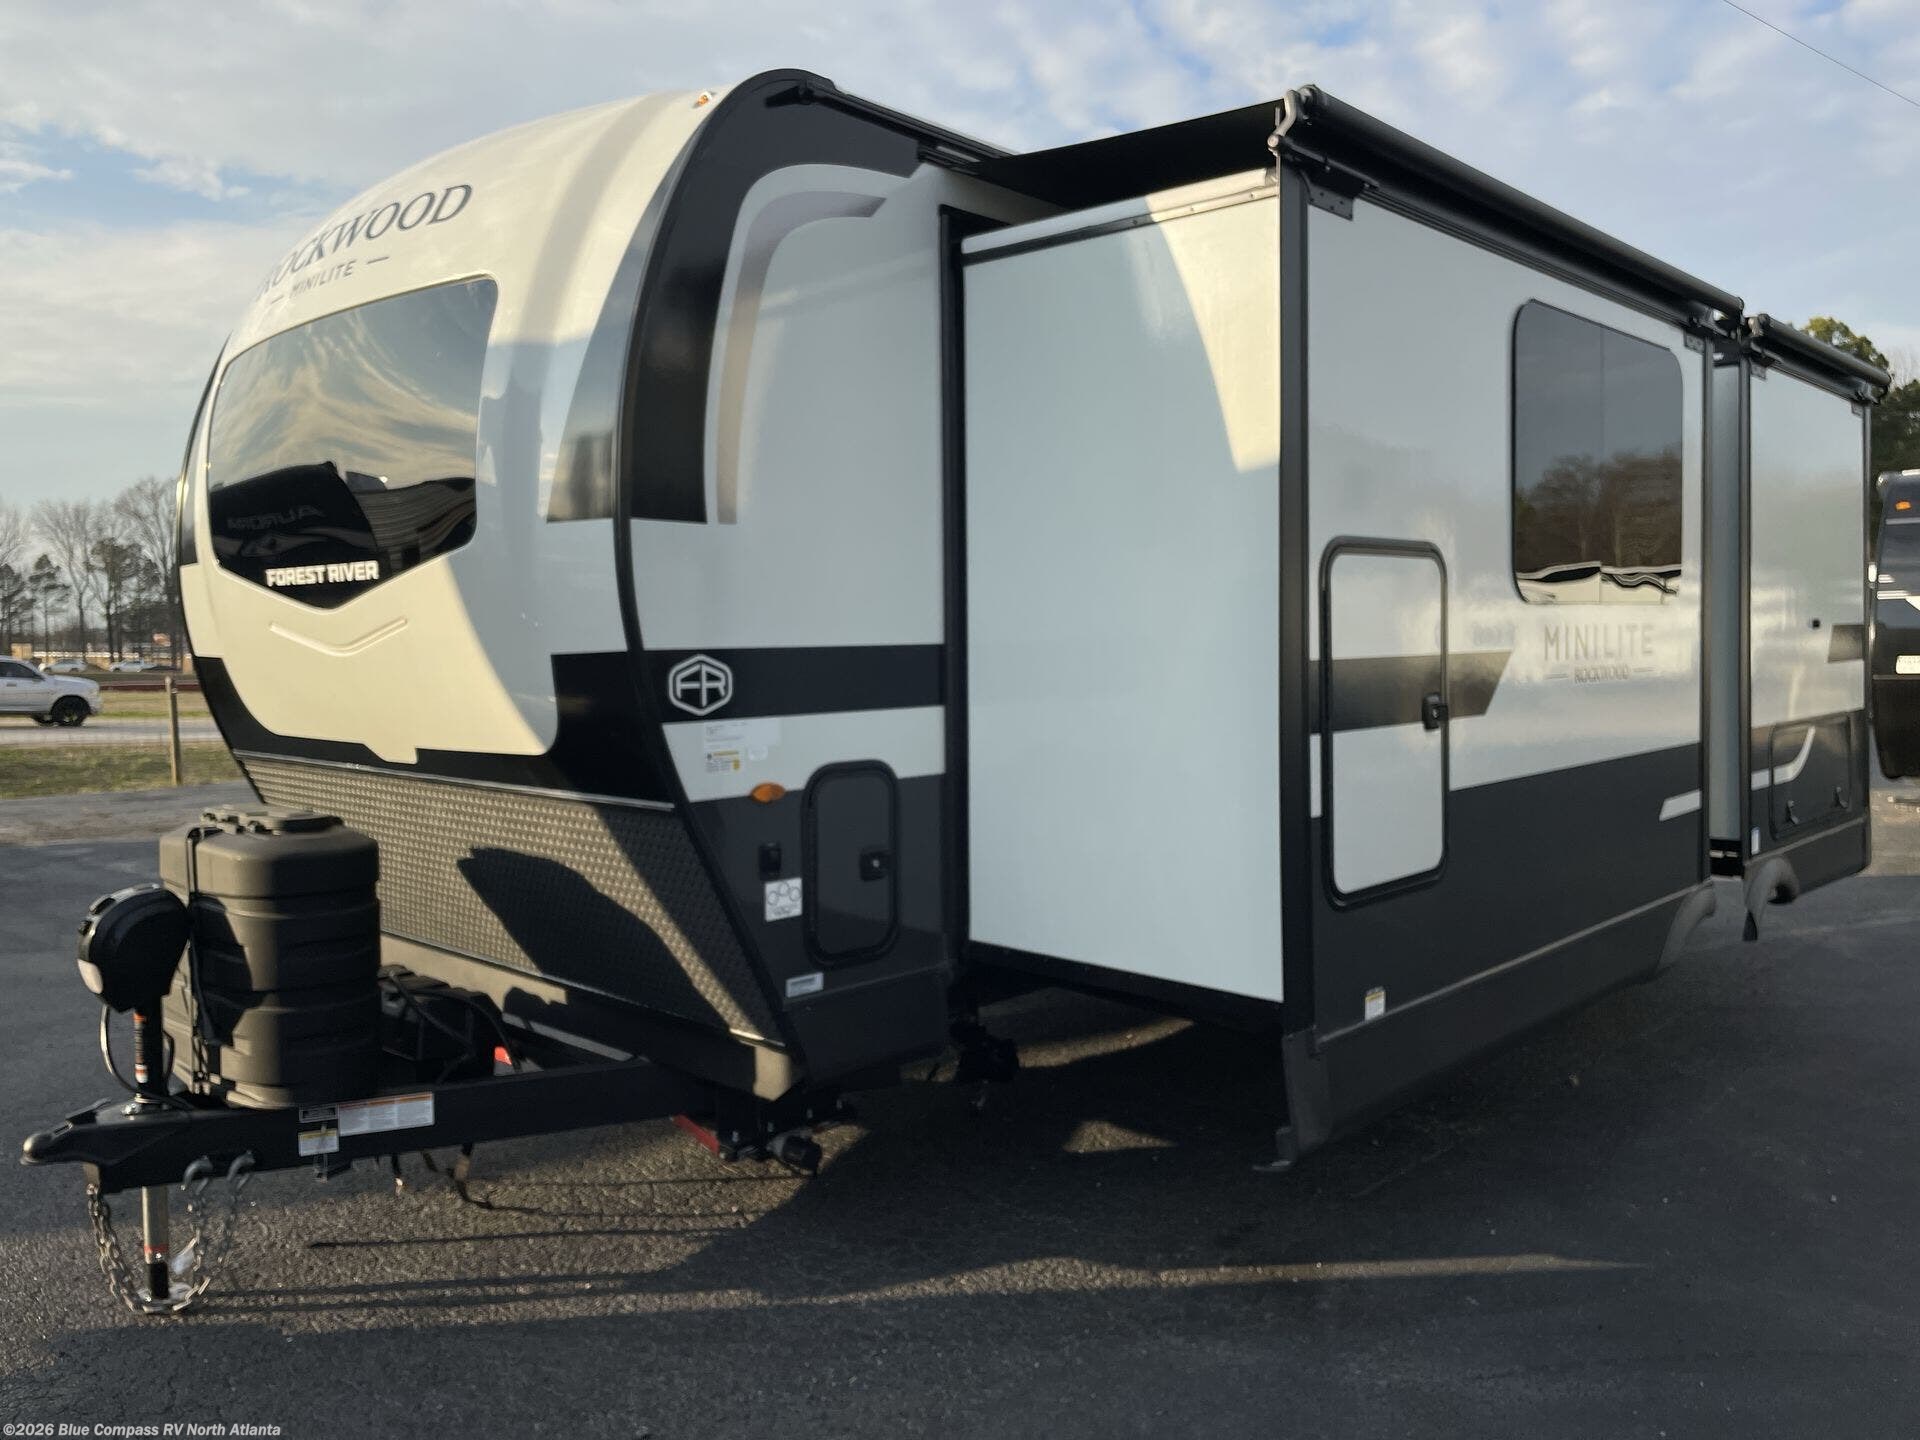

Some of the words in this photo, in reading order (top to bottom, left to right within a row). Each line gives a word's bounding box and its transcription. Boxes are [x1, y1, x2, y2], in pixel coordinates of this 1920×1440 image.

[290, 259, 356, 298] MINILITE
[265, 564, 326, 587] FOREST
[326, 560, 379, 583] RIVER
[1543, 623, 1654, 661] MINILITE
